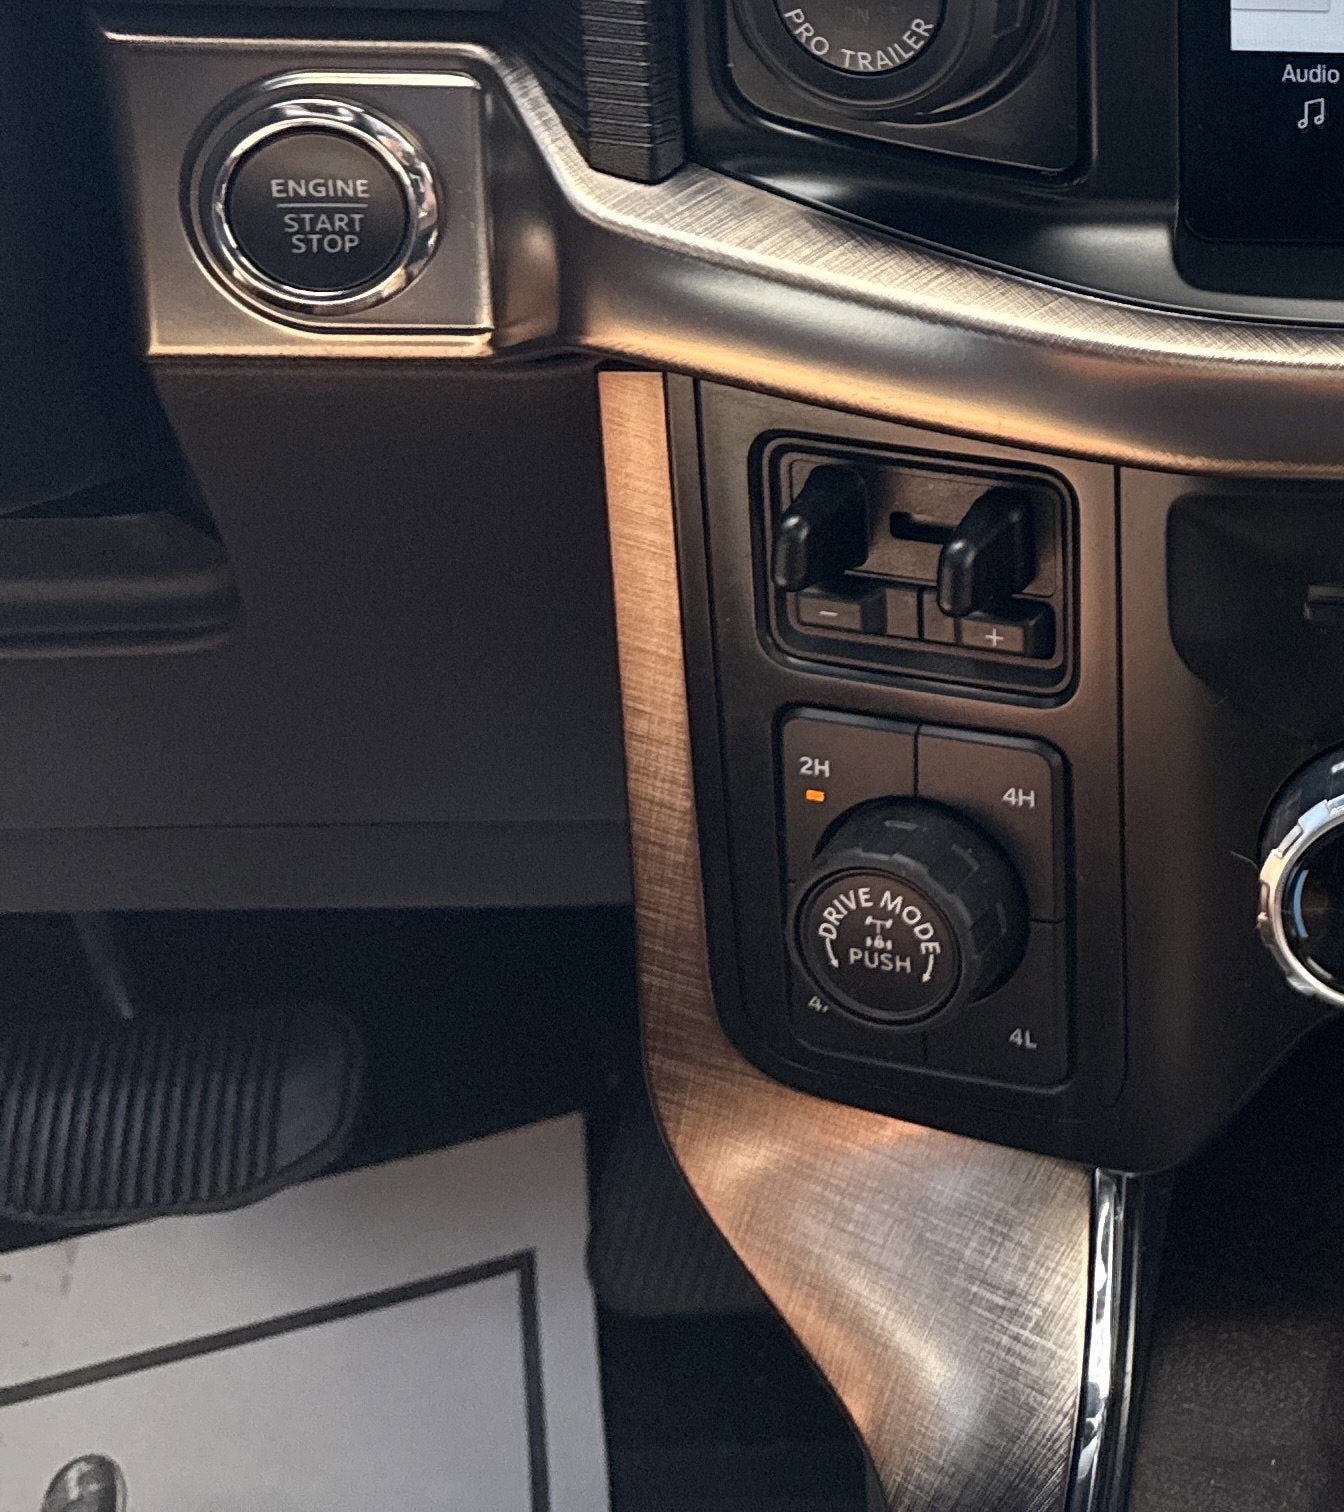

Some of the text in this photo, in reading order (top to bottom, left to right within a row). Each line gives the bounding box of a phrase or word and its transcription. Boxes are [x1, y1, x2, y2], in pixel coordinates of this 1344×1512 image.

[784, 8, 829, 56] PRO
[840, 17, 934, 71] TRAILER
[1281, 63, 1341, 86] Audio
[271, 178, 371, 199] ENGINE
[284, 213, 364, 233] START
[291, 234, 360, 254] STOP
[799, 755, 831, 779] 2H
[1002, 786, 1036, 809] 4H
[818, 887, 942, 956] DRIVE MODE
[849, 946, 913, 975] PUSH
[1009, 1027, 1038, 1050] 4L
